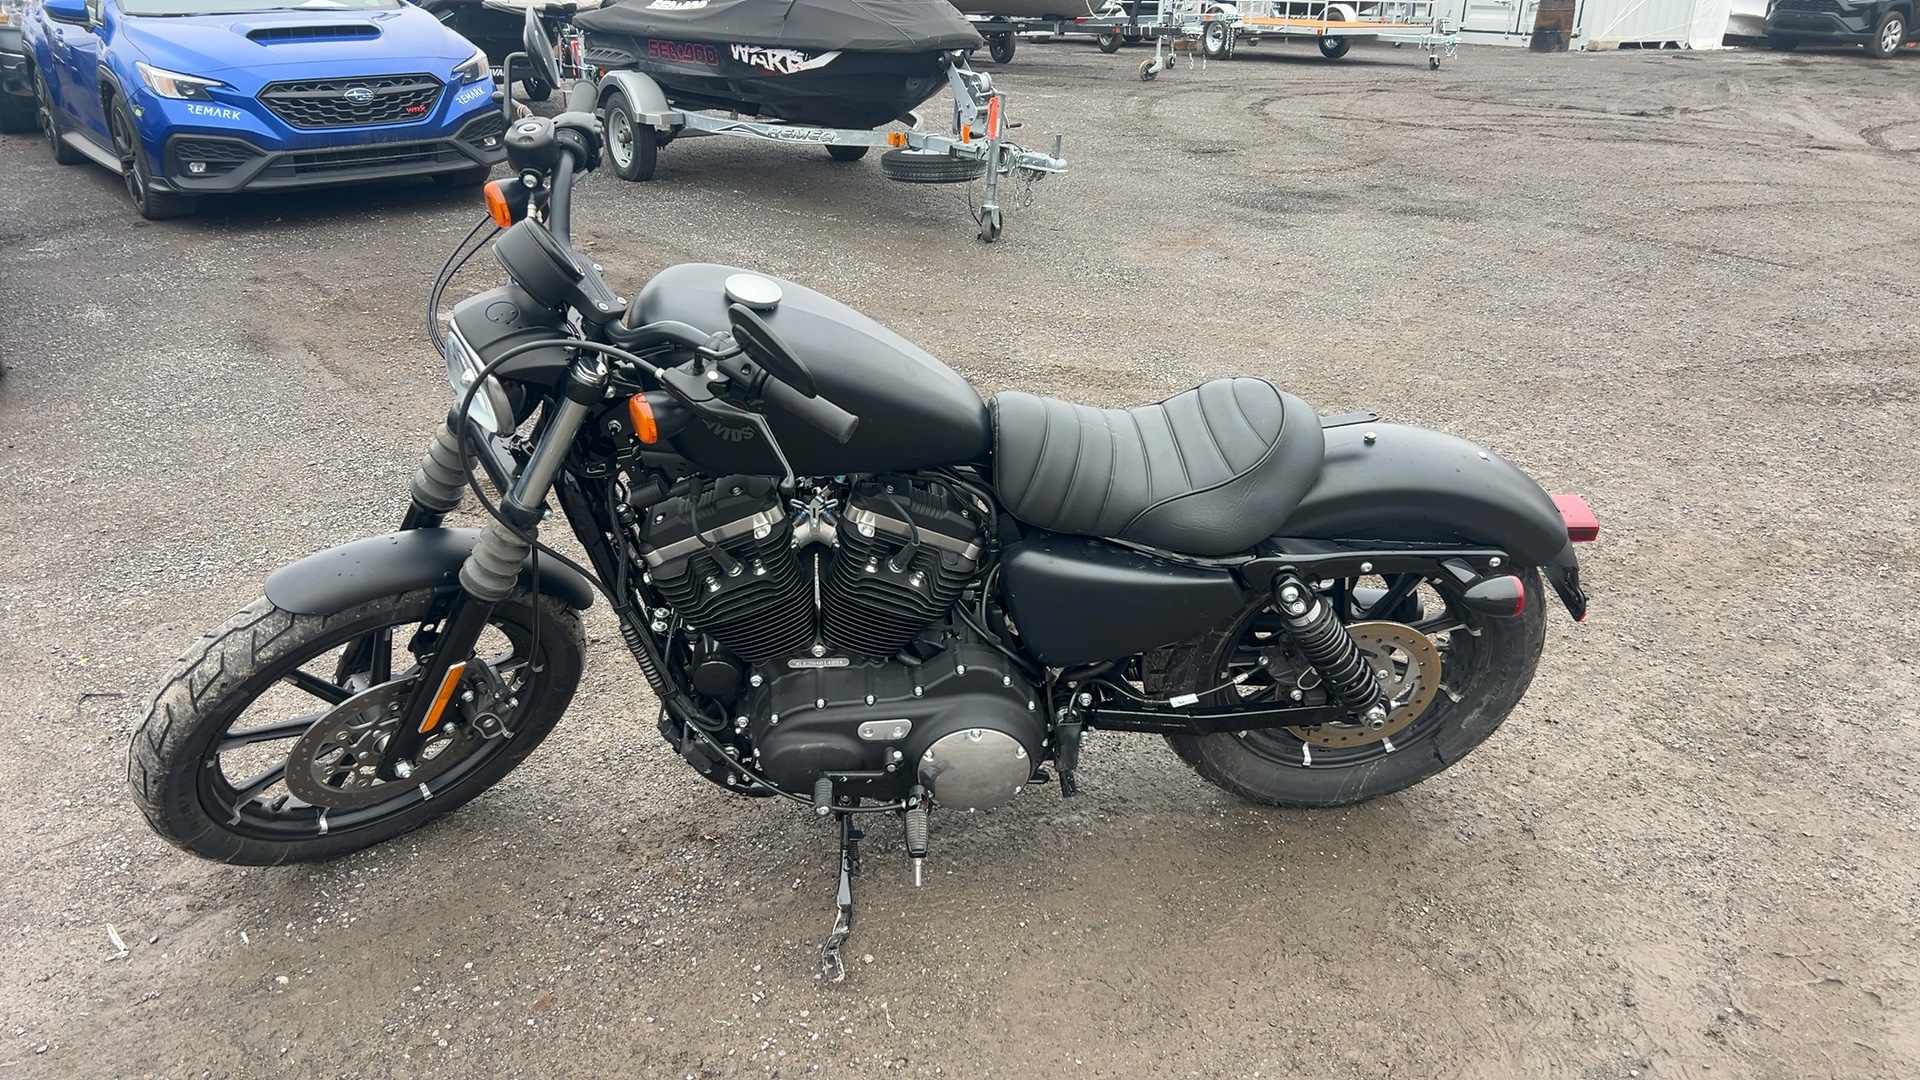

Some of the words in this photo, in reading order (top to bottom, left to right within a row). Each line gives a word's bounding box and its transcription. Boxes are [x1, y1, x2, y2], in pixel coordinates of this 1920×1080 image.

[455, 86, 486, 105] REMARK
[187, 103, 241, 121] REMARK
[406, 104, 426, 113] WRX
[767, 125, 838, 144] REMEQ
